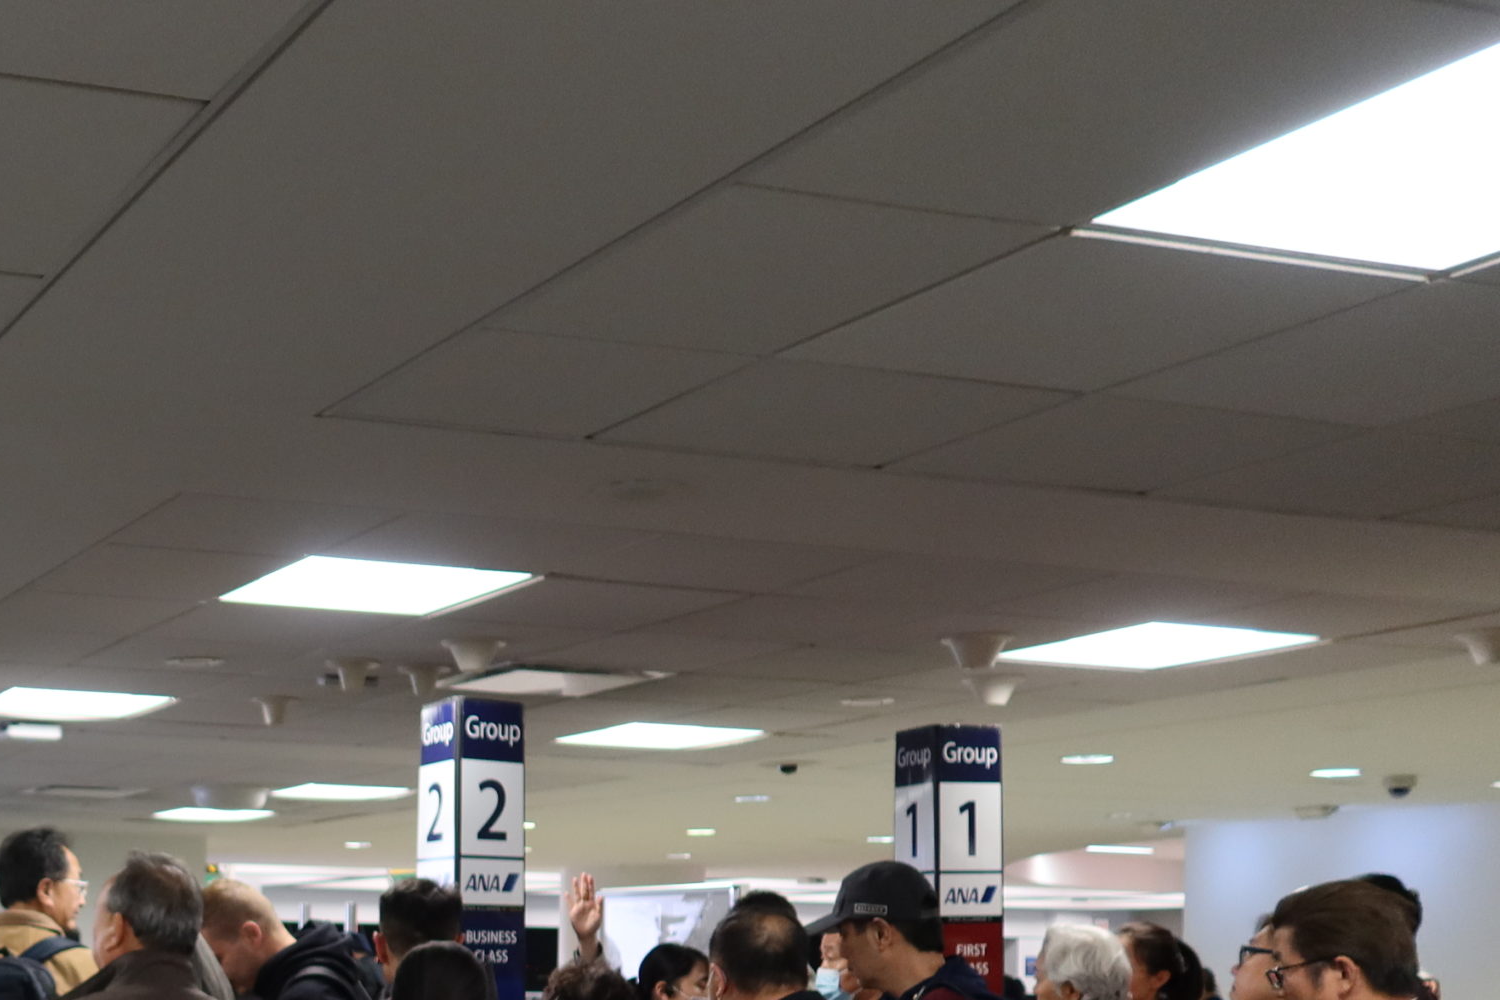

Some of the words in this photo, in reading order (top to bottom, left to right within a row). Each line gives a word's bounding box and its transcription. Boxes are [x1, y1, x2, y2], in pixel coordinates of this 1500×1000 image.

[421, 722, 454, 746] Group
[465, 714, 521, 747] Group
[897, 747, 931, 768] Group
[942, 741, 998, 770] Group
[426, 782, 443, 842] 2
[476, 779, 507, 841] 2
[906, 801, 917, 858] 1
[958, 800, 976, 857] 1
[464, 873, 500, 892] ANA
[944, 887, 979, 904] ANA
[466, 929, 518, 945] BUSINESS
[956, 942, 988, 957] FIRST
